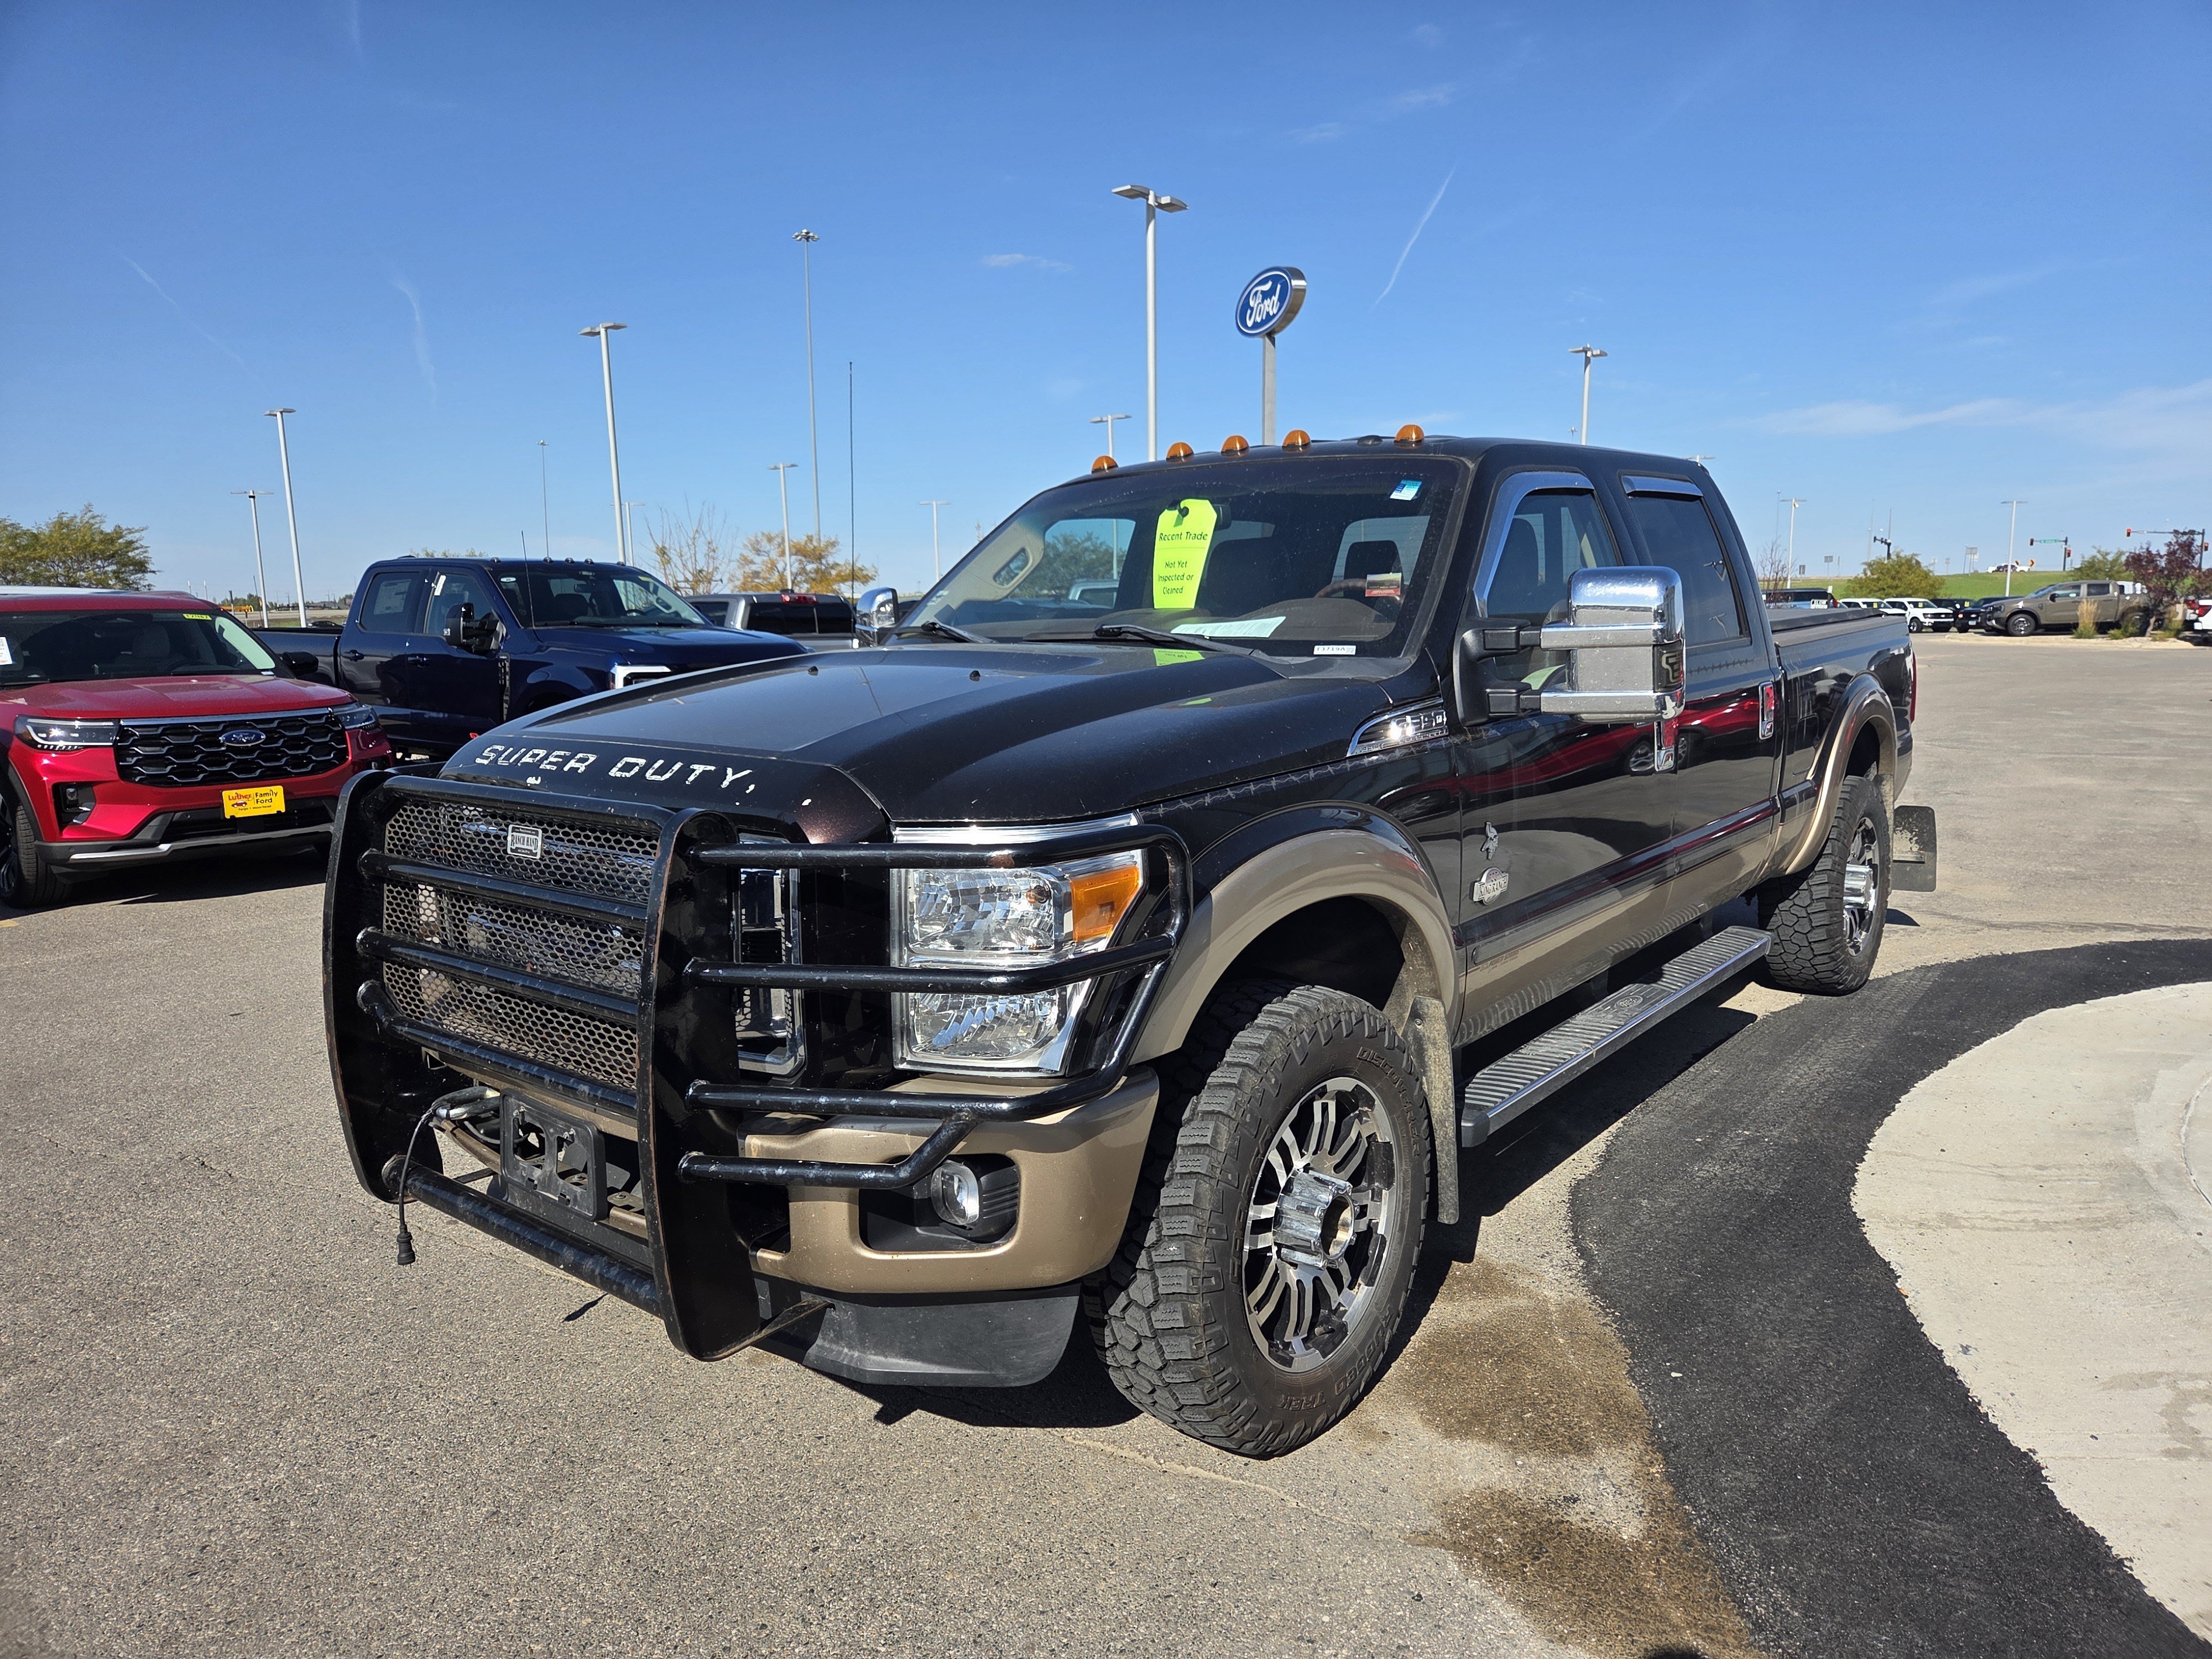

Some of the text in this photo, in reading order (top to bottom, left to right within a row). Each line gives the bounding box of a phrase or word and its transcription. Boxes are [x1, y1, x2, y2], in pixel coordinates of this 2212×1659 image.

[1246, 279, 1281, 327] Ford
[1159, 531, 1208, 541] Recent Trade
[1158, 573, 1185, 583] Inspected
[1162, 586, 1183, 595] Cleaned
[476, 745, 597, 773] SUPER
[255, 789, 278, 797] Family
[511, 834, 525, 847] RANCH
[1357, 1047, 1421, 1156] DISCOVERER
[1278, 1391, 1326, 1411] TREK
